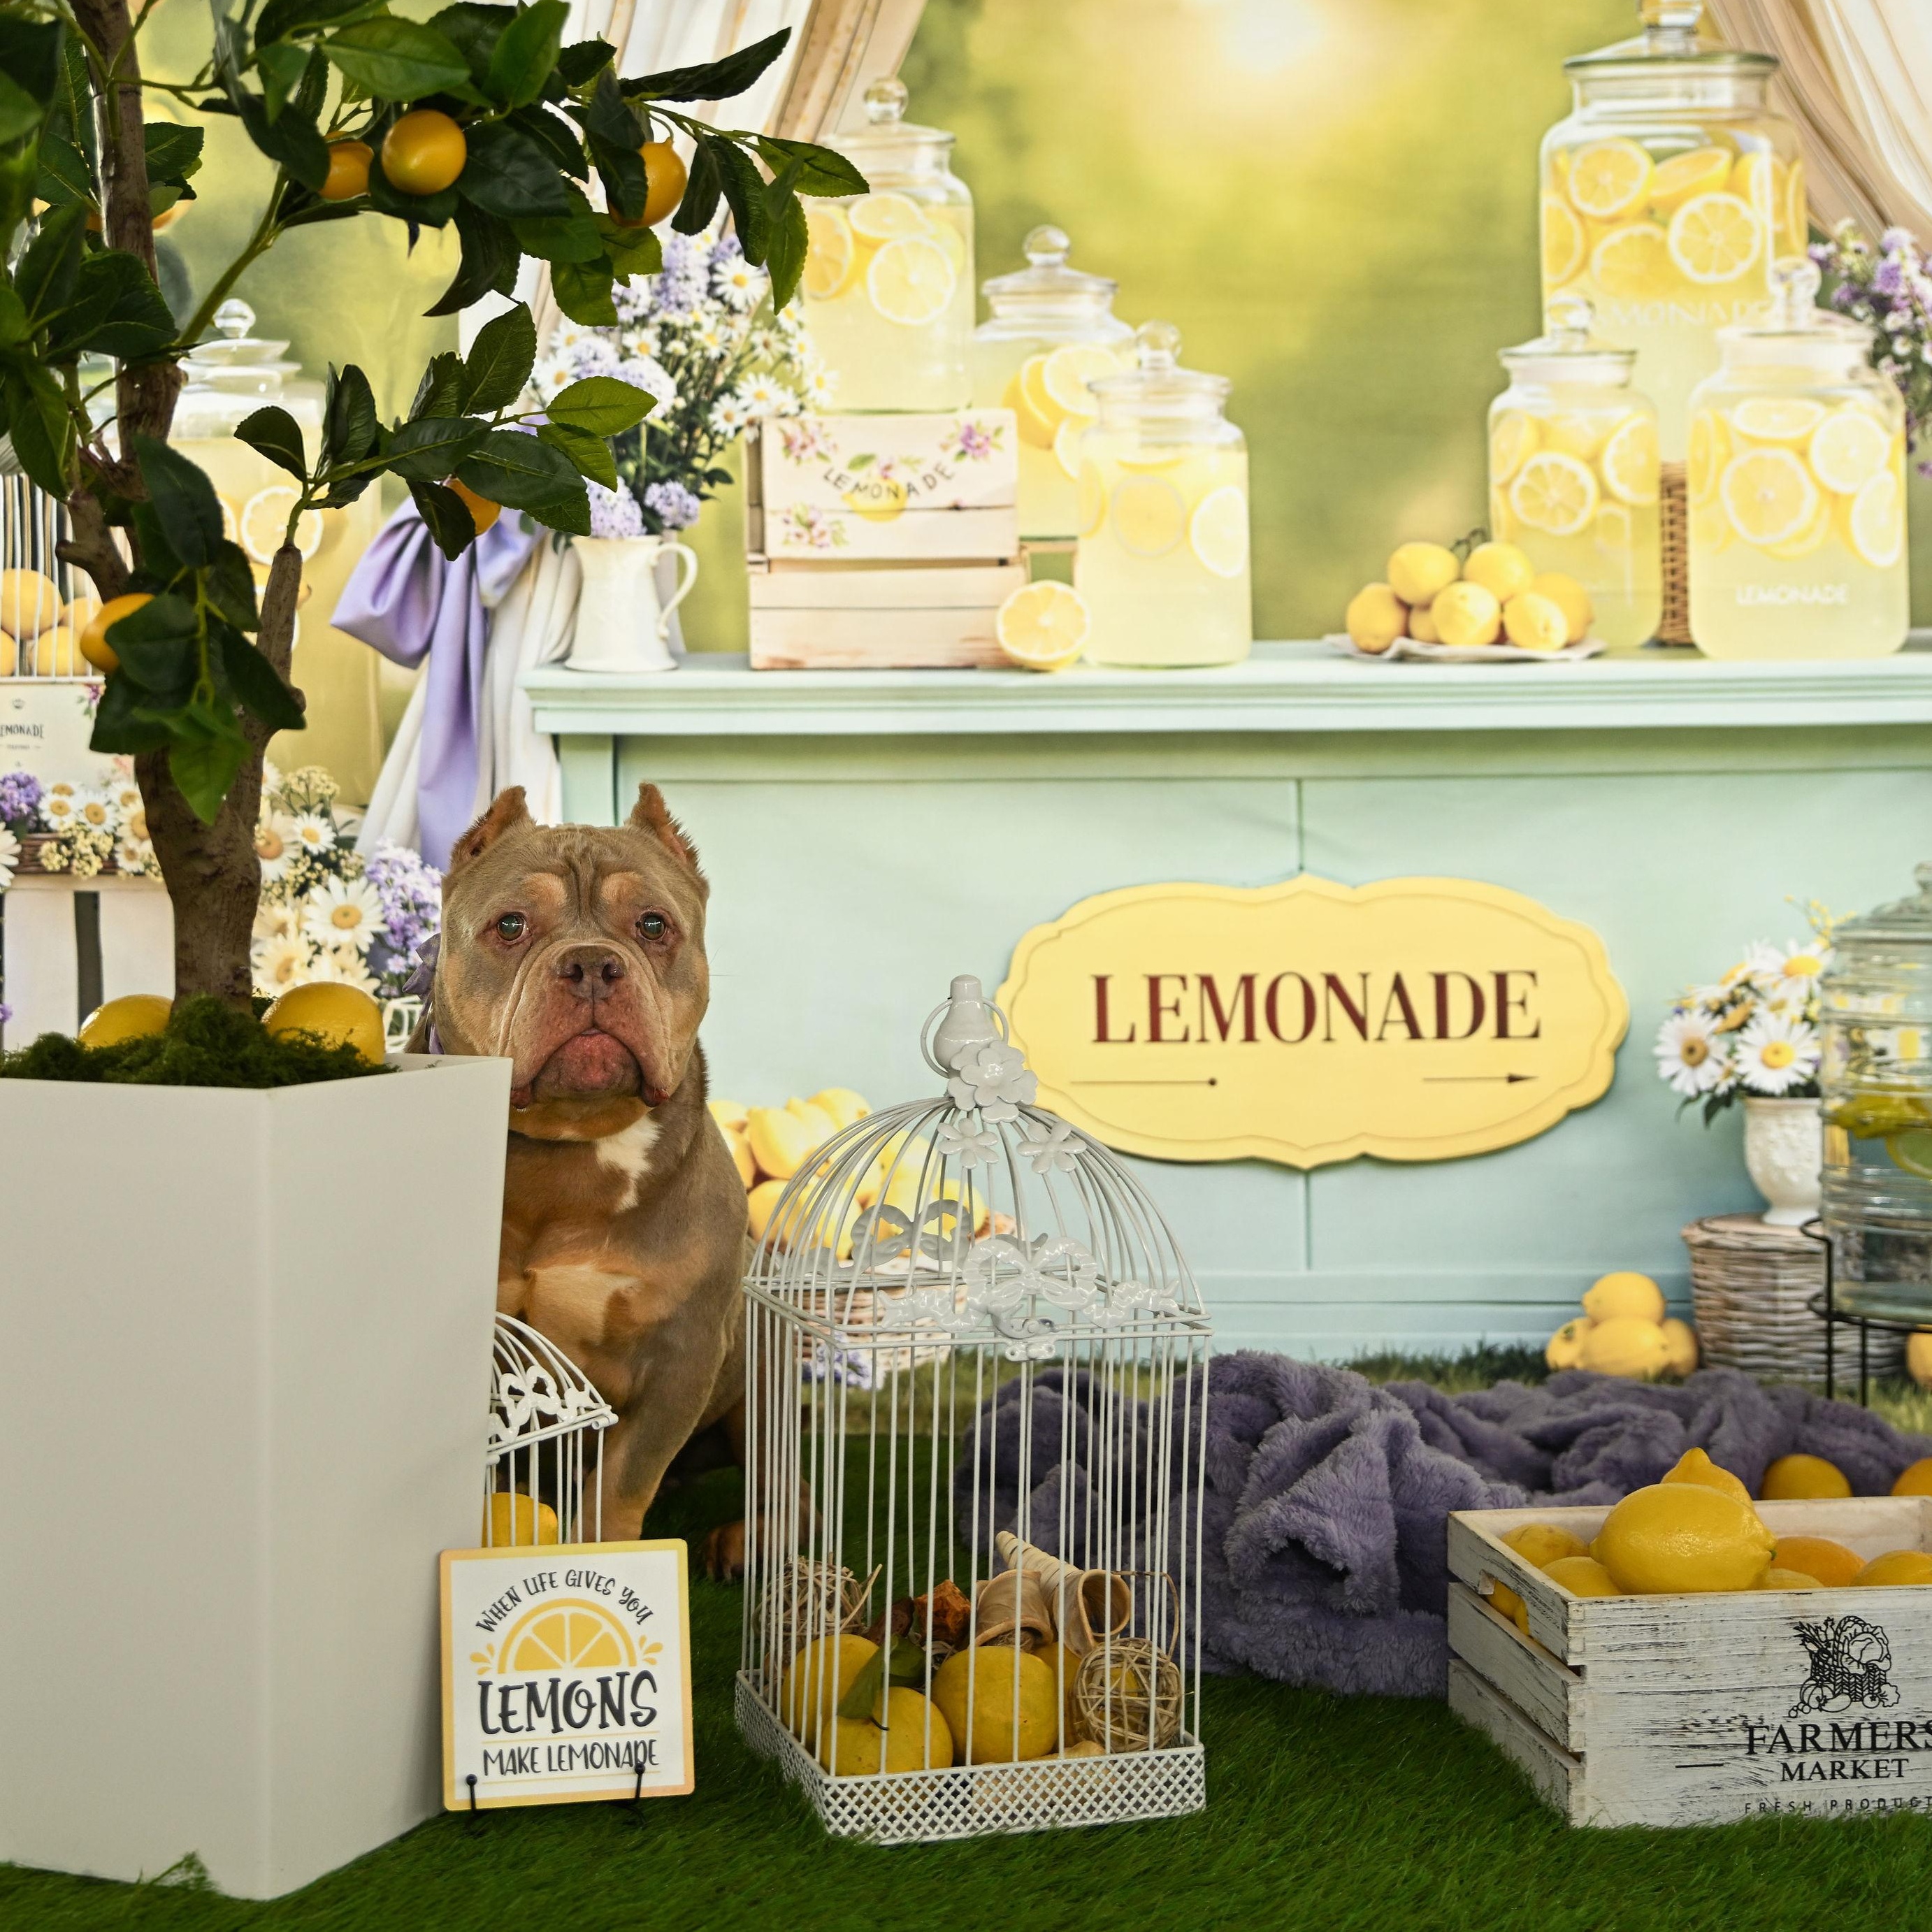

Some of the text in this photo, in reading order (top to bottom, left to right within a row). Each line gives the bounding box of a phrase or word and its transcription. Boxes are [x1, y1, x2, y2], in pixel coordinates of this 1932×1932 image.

[823, 462, 956, 500] LEMONADE
[1736, 583, 1848, 605] LEMONADE
[1090, 970, 1541, 1044] LEMONADE
[475, 1569, 654, 1633] WHEN LIFE GIVES YOU
[477, 1669, 658, 1734] LEMONS
[483, 1739, 659, 1776] MAKE LEMONADE
[1780, 1758, 1909, 1782] MARKET
[1745, 1801, 1812, 1815] FRESH
